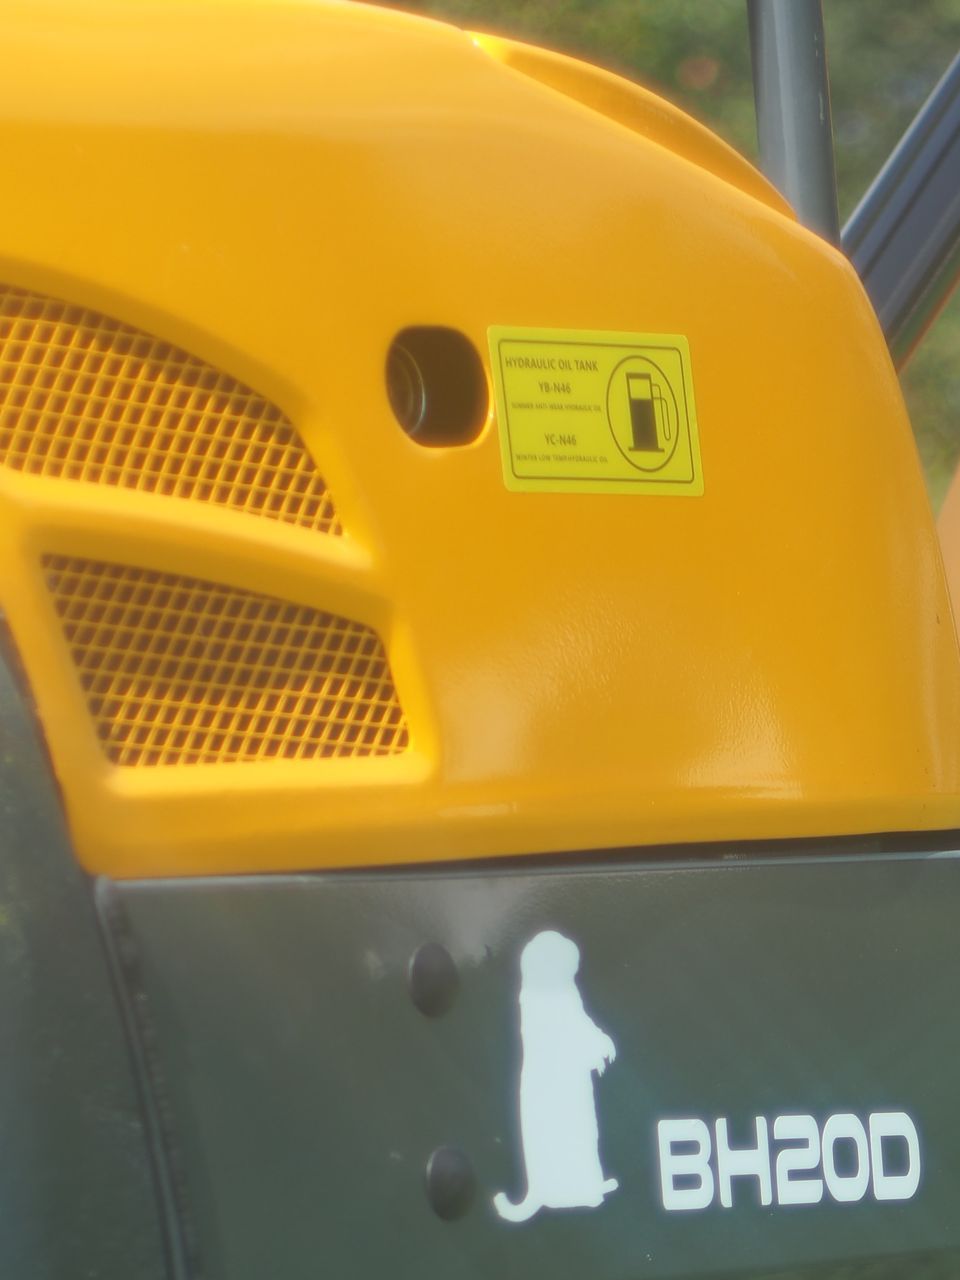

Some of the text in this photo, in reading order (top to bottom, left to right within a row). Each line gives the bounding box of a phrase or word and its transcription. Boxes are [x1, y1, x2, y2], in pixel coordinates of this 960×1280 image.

[505, 358, 598, 371] HYDRAULIC OIL TANK
[539, 381, 571, 393] YB-N46
[544, 433, 576, 446] YC-N46
[657, 1112, 921, 1210] BH20D
